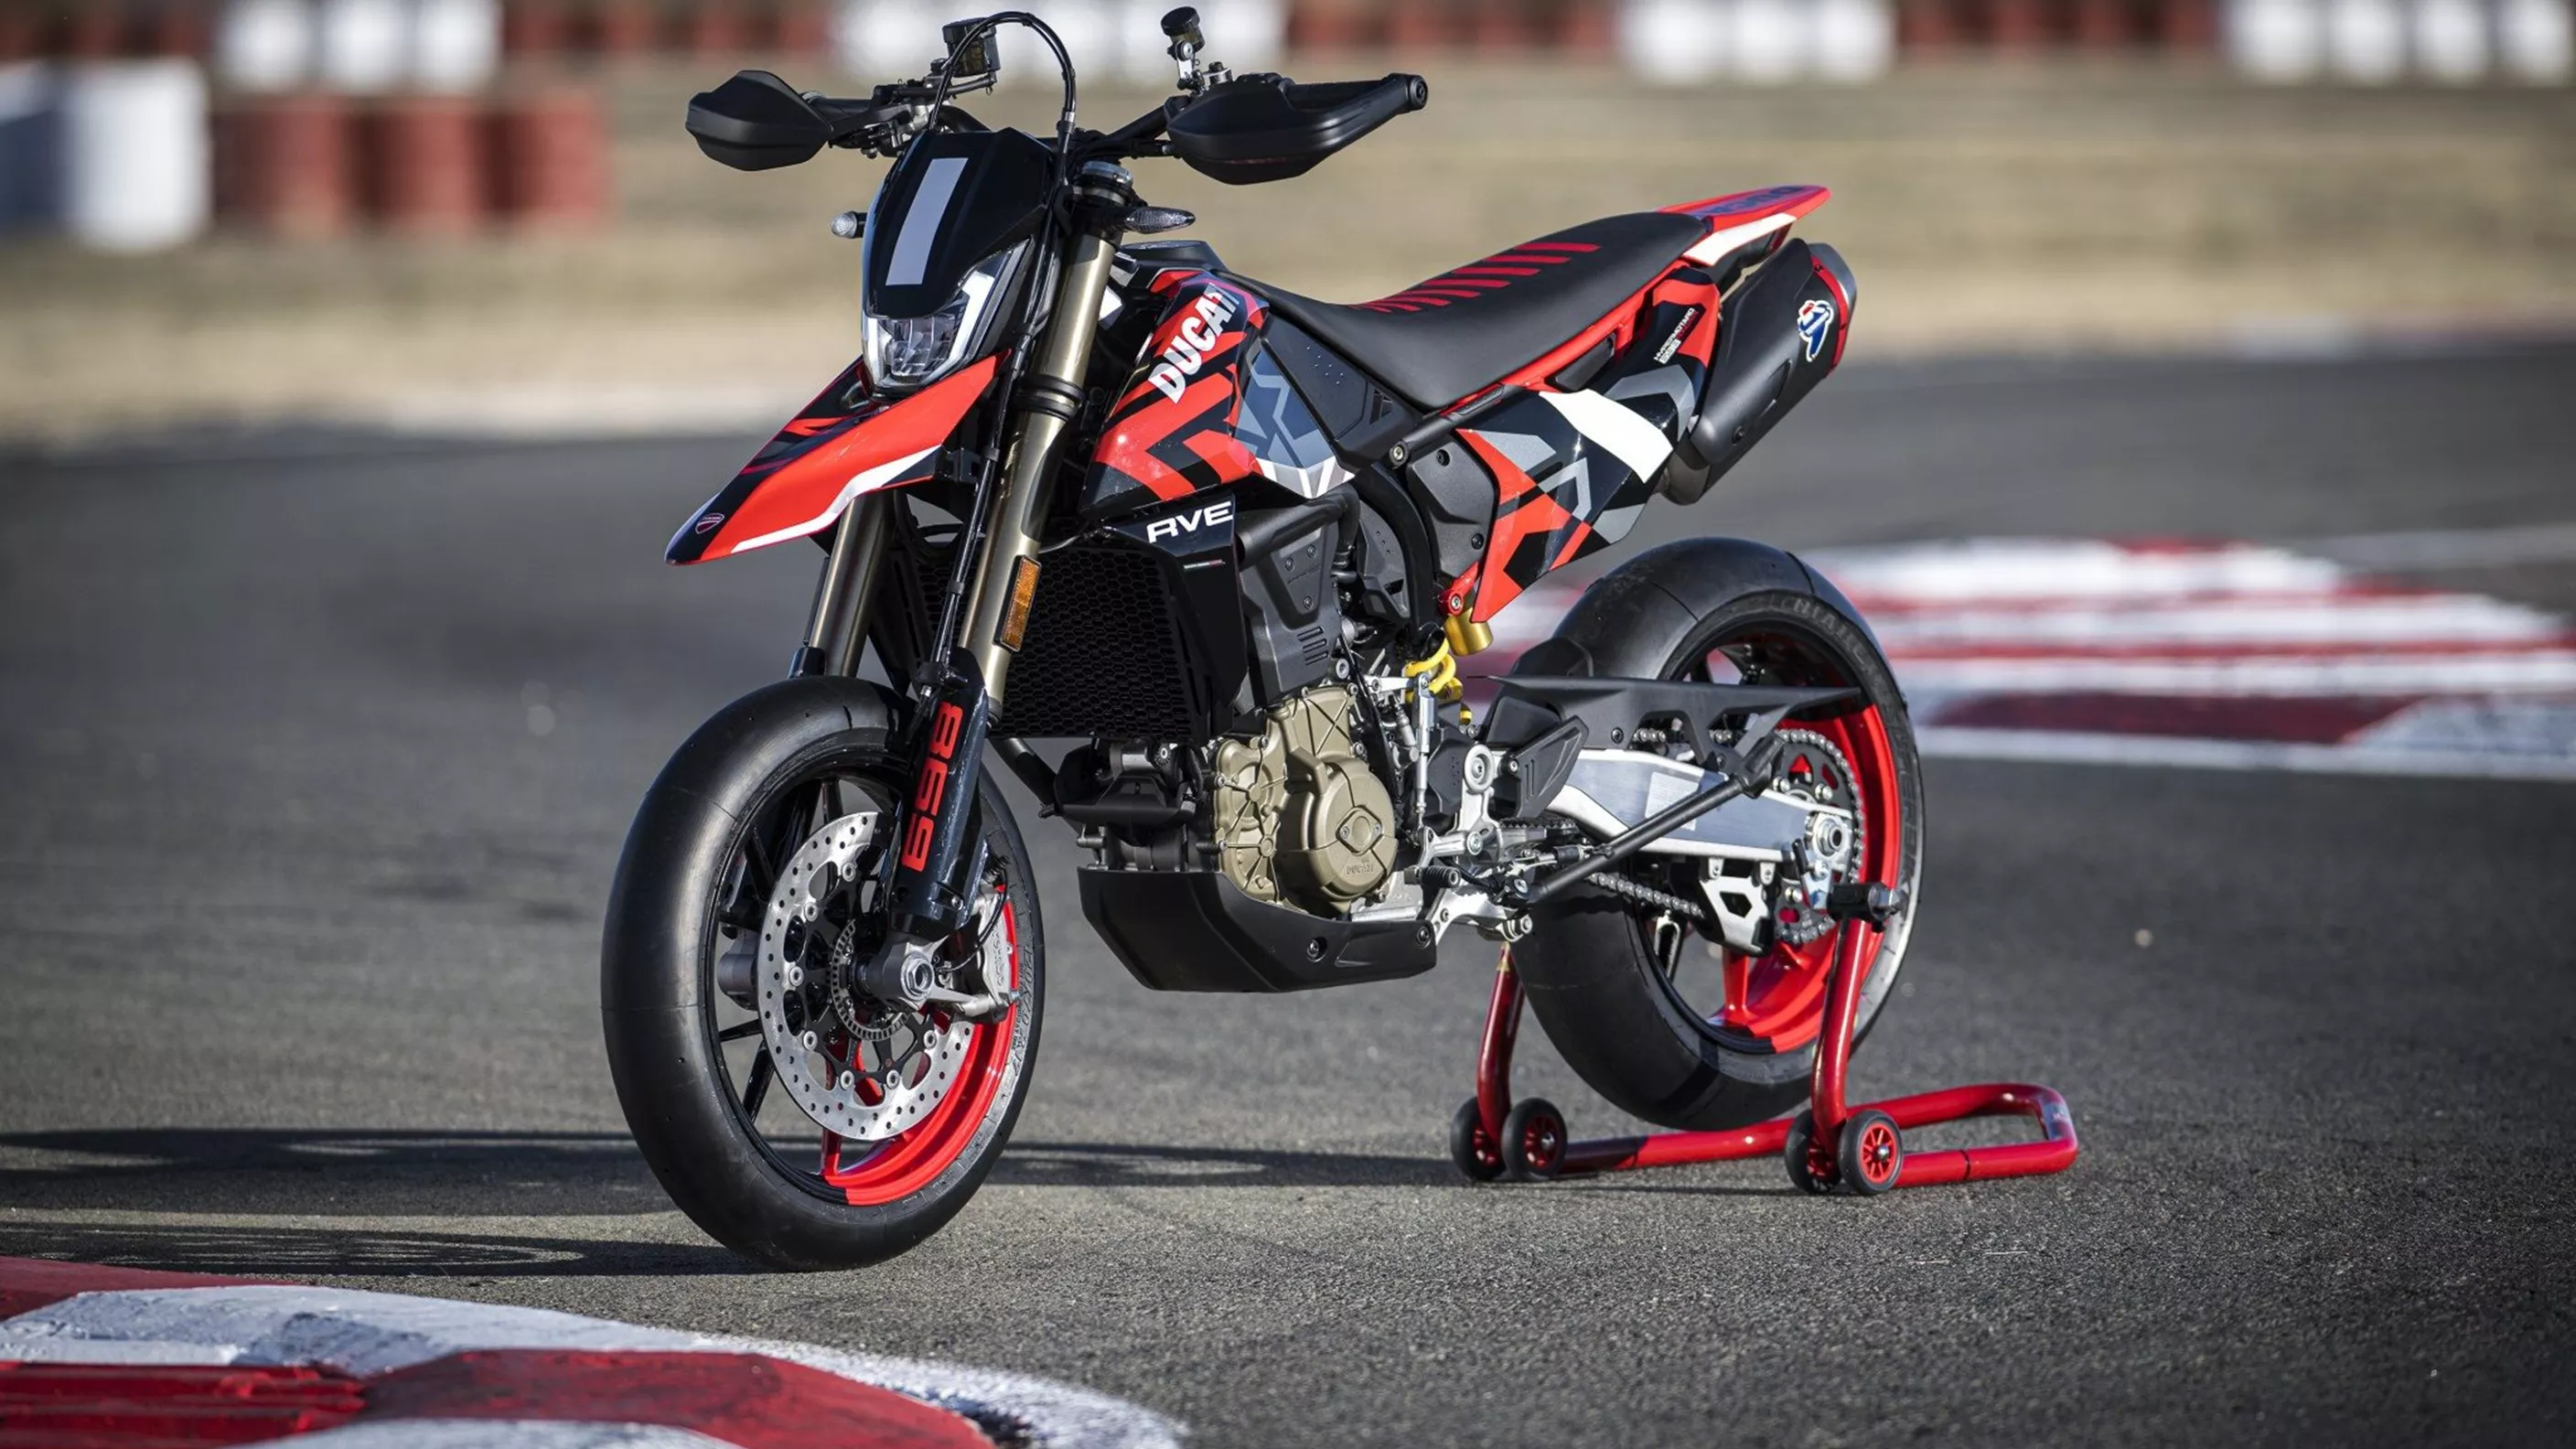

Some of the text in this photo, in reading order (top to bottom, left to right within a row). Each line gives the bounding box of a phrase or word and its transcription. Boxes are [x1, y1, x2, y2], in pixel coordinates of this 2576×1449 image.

[1147, 283, 1240, 404] DUCATI
[1146, 500, 1233, 543] RVE
[901, 702, 963, 872] 698
